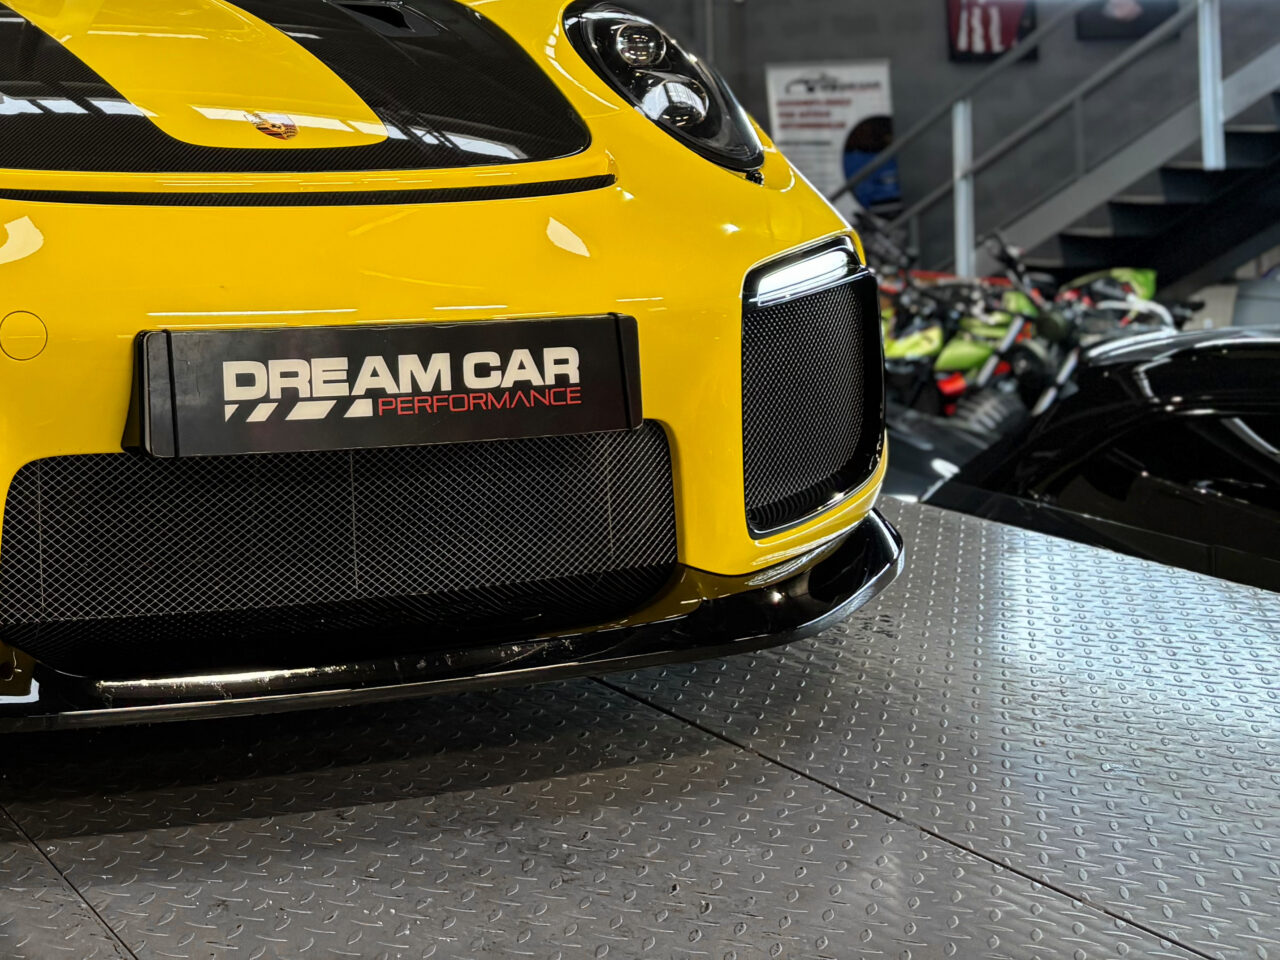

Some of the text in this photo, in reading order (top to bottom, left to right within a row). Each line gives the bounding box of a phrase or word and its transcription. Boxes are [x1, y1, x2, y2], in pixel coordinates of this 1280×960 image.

[223, 346, 580, 401] DREAM CAR
[378, 386, 582, 416] PERFORMANCE
